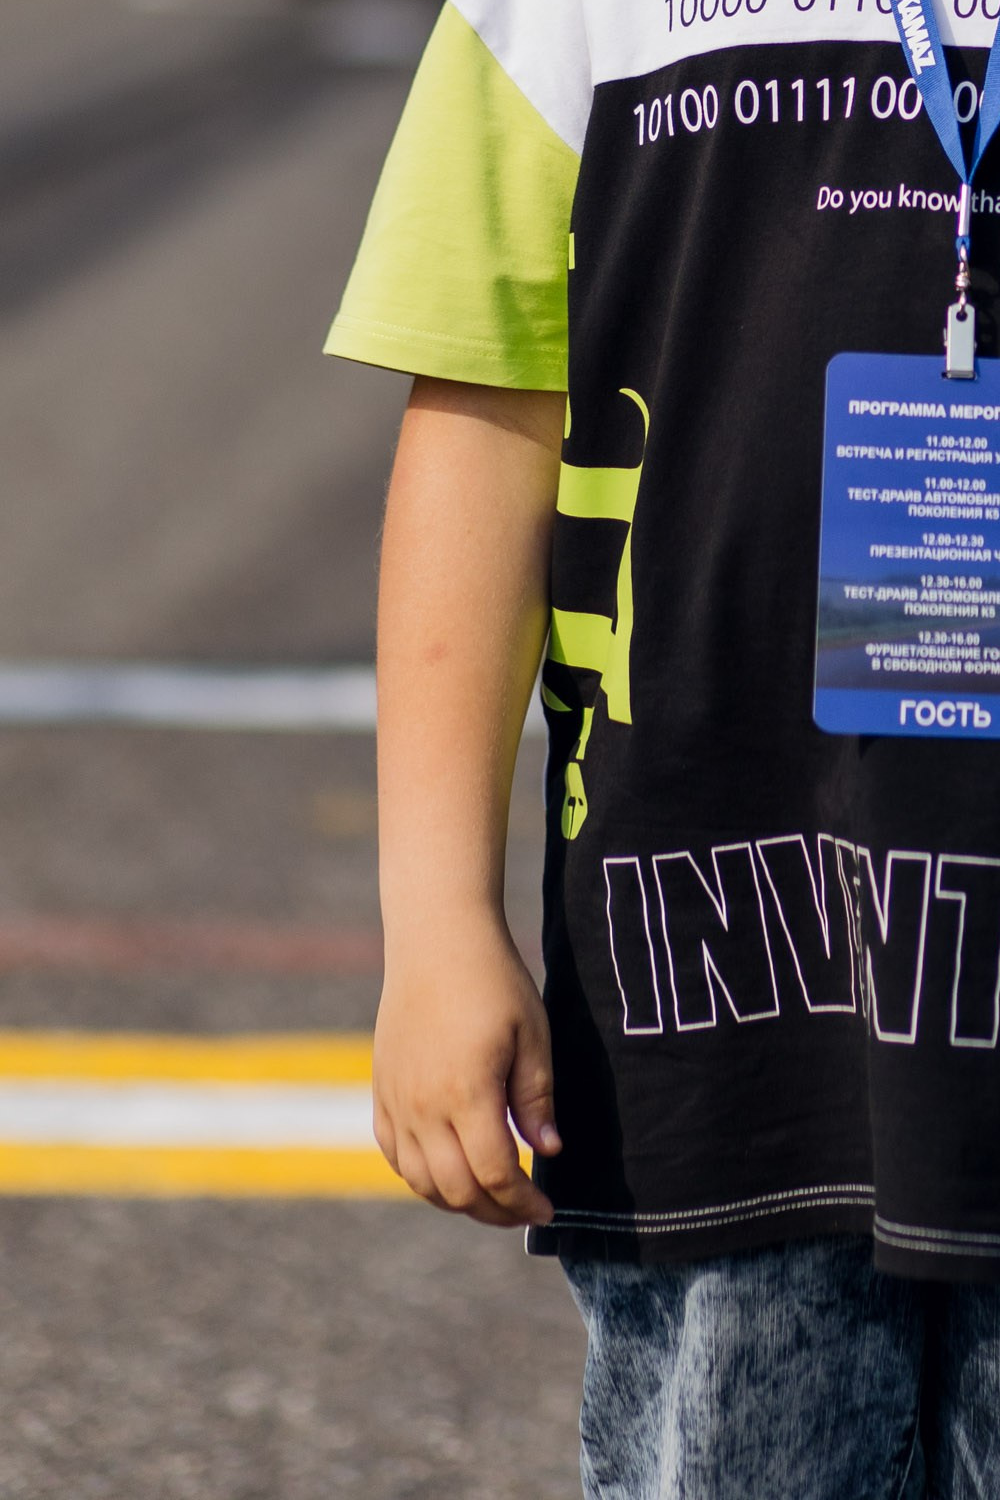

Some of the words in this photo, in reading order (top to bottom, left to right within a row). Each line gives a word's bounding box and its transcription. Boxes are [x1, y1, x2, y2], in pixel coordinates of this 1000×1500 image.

[633, 83, 719, 146] 10100
[734, 77, 855, 125] 01111
[870, 75, 984, 123] 000
[816, 186, 844, 210] Do
[849, 189, 892, 214] you
[898, 183, 960, 212] know
[848, 399, 947, 418] ПРОГРАММА
[925, 435, 988, 449] 11.00-12.00
[836, 445, 893, 460] ВСТРЕЧА
[895, 448, 902, 460] И
[906, 447, 993, 465] РЕГИСТРАЦИЯ
[923, 477, 986, 491] 11.00-12.00
[847, 486, 922, 504] ТЕСТ-ДРАЙВ
[908, 505, 983, 519] ПОКОЛЕНИЯ
[922, 533, 984, 547] 12.00-12.30
[869, 544, 992, 562] ПРЕЗЕНТАЦИОННАЯ
[843, 585, 918, 602] ТЕСТ-ДРАЙВ
[904, 604, 979, 618] ПОКОЛЕНИЯ
[871, 658, 880, 670] В
[883, 658, 962, 674] СВОБОДНОМ
[900, 699, 992, 728] ГОСТЬ
